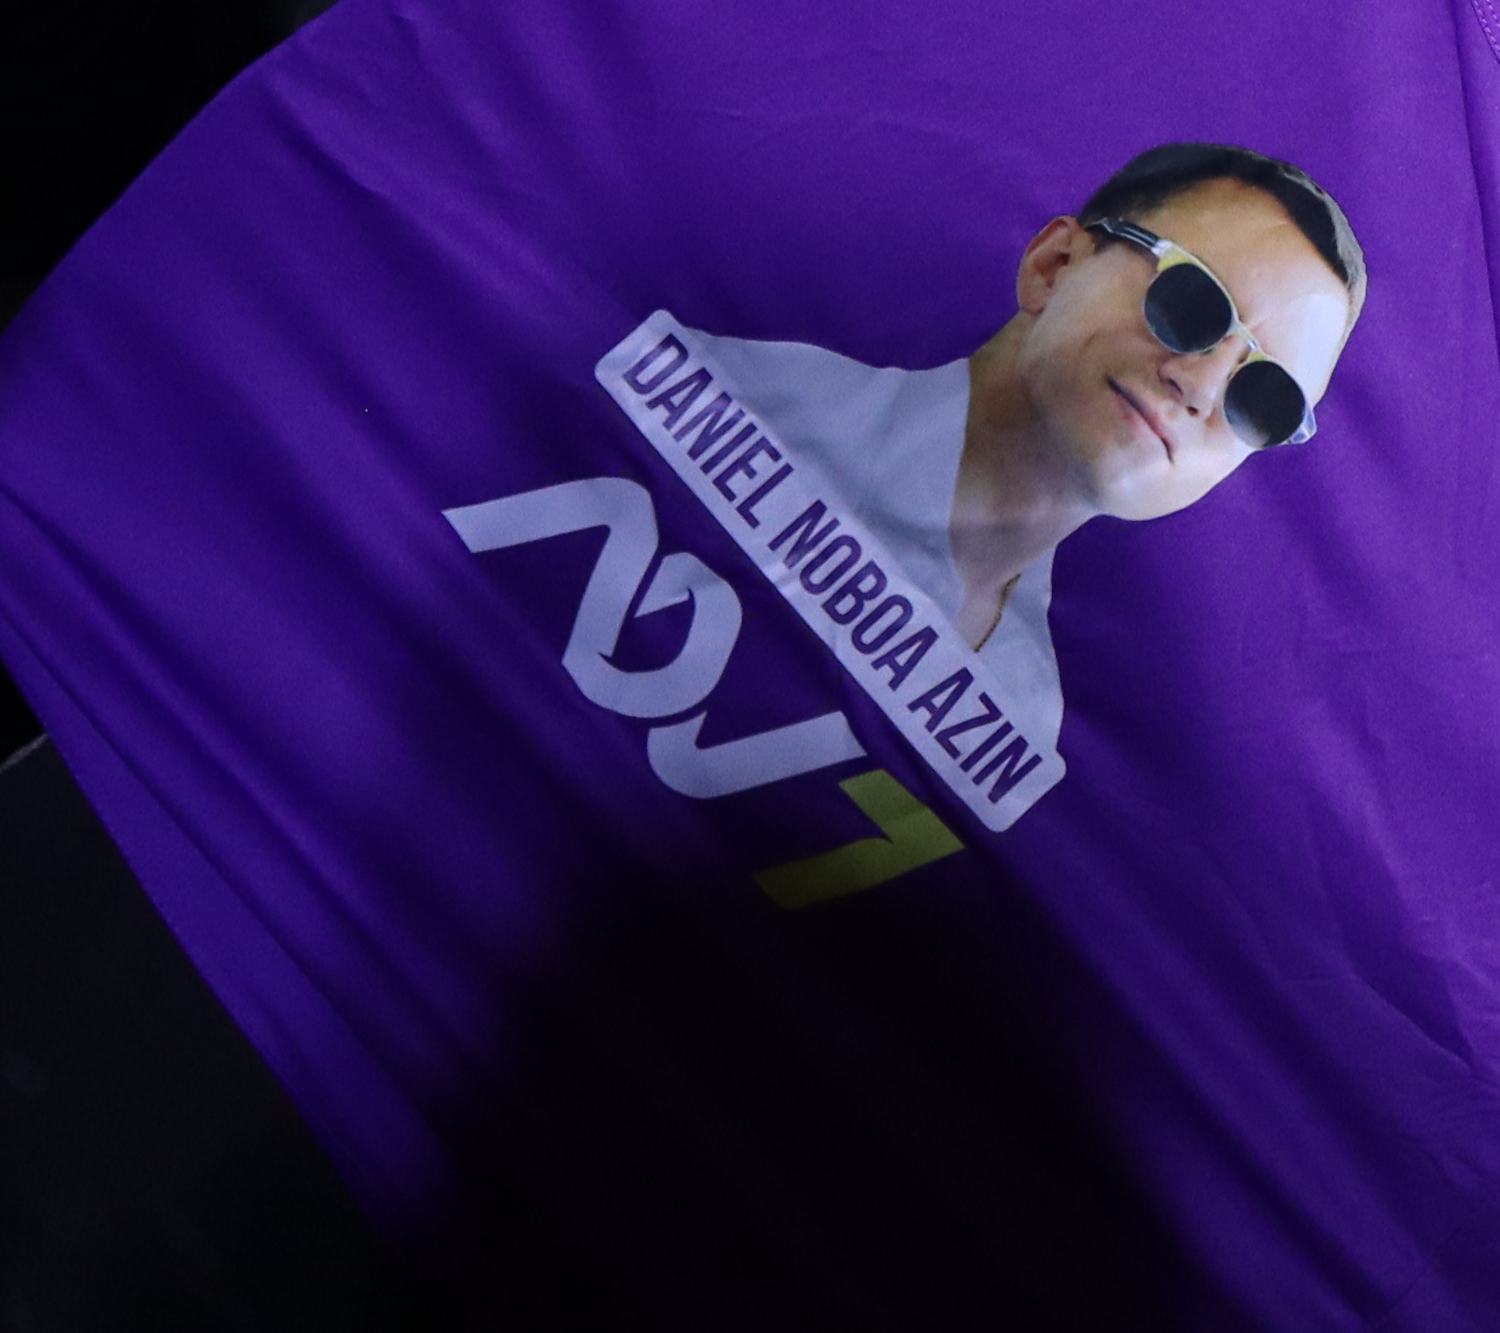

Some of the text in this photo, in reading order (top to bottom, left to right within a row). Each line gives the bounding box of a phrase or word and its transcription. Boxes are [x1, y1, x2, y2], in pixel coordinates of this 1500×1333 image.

[622, 332, 1043, 806] DANIEL NOBOA AZIN
